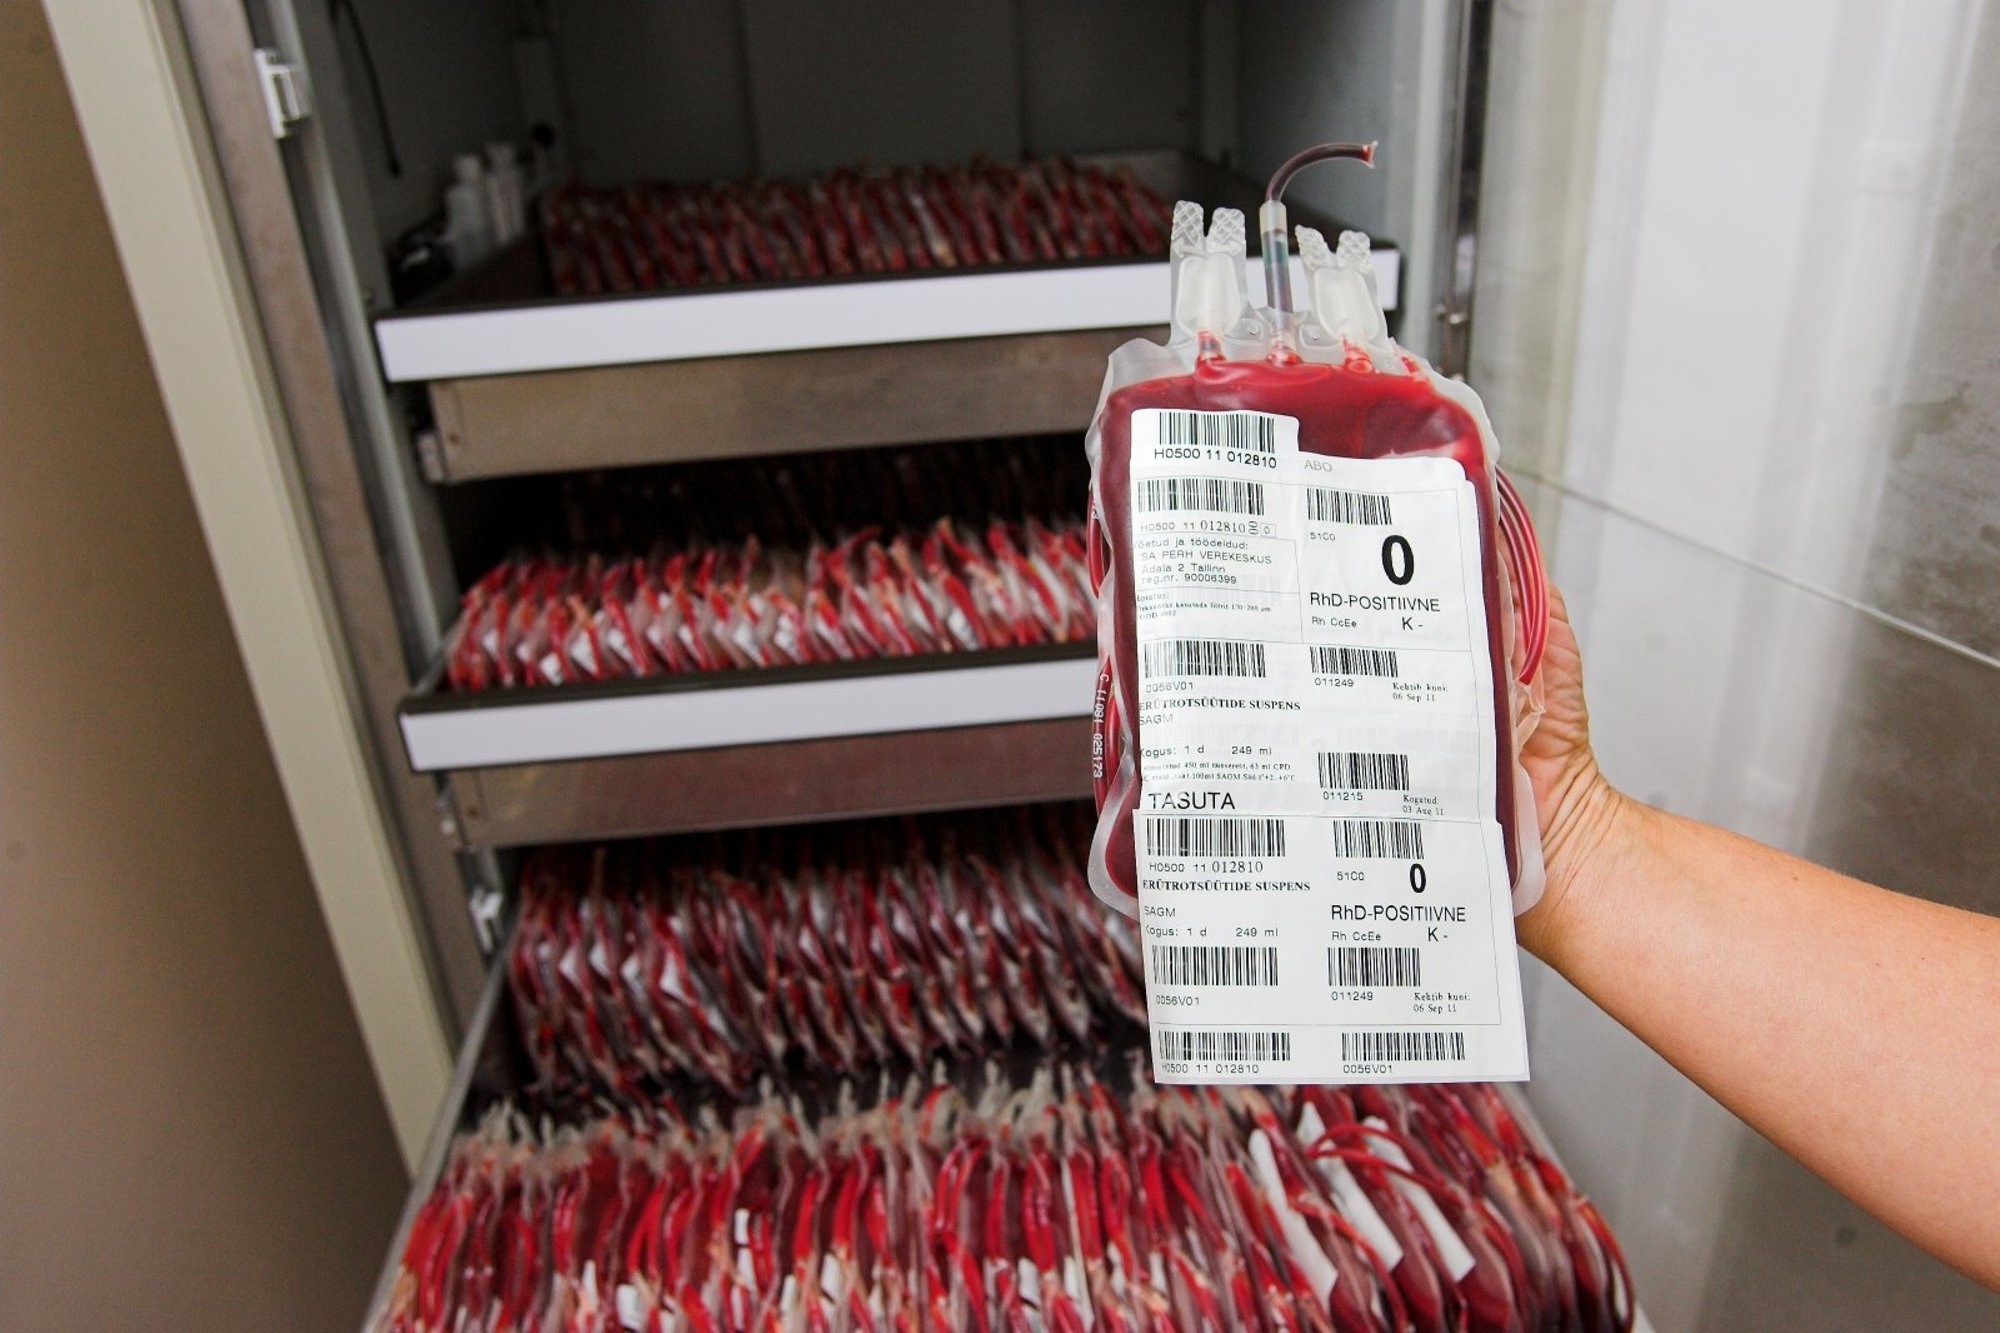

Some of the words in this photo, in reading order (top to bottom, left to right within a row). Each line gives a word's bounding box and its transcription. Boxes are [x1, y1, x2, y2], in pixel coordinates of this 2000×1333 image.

[1154, 448, 1200, 460] H0500
[1206, 450, 1220, 461] 11
[1227, 451, 1276, 468] 012810
[1304, 459, 1332, 472] ABO
[1141, 522, 1175, 532] H0500
[1183, 522, 1195, 530] 11
[1200, 520, 1246, 533] 012810
[1176, 538, 1185, 548] ja
[1191, 538, 1249, 550] töödeldud:
[1141, 552, 1157, 562] SA
[1162, 550, 1193, 560] PERH
[1200, 551, 1272, 564] VEREKESKUS
[1178, 563, 1185, 572] 2
[1192, 563, 1225, 573] Tallinn
[1185, 573, 1237, 584] 90006399
[1310, 592, 1441, 612] RhD-POSITIIVNE
[1312, 616, 1325, 626] Rh
[1331, 617, 1357, 628] CcEe
[1314, 677, 1354, 688] 011249
[1393, 682, 1422, 692] Kehtib
[1406, 693, 1422, 702] Sep
[1249, 698, 1301, 711] SUSPENS
[1139, 714, 1173, 726] SAGM
[1184, 746, 1190, 754] 1
[1197, 745, 1205, 754] d
[1232, 745, 1252, 755] 249
[1259, 746, 1272, 755] ml
[1148, 791, 1236, 810] TASUTA
[1323, 791, 1363, 801] 011215
[1415, 806, 1432, 816] Aug
[1149, 863, 1185, 873] H0500
[1194, 864, 1206, 873] 11
[1212, 861, 1263, 873] 012810
[1337, 872, 1365, 881] 51C0
[1143, 878, 1252, 891] ERÜTROTSÜÜTIDE
[1255, 881, 1311, 891] SUSPENS
[1144, 905, 1176, 917] SAGM
[1331, 905, 1466, 922] RhD-POSITIIVNE
[1187, 927, 1192, 936] 1
[1200, 926, 1207, 936] d
[1236, 927, 1257, 937] 249
[1264, 927, 1278, 937] ml
[1332, 931, 1347, 941] Rh
[1353, 931, 1381, 941] CcEe
[1155, 994, 1199, 1006] 0056V01
[1331, 991, 1373, 1001] 011249
[1414, 992, 1443, 1001] Kehtib
[1413, 1004, 1424, 1013] 06
[1428, 1004, 1443, 1014] Sep
[1448, 1004, 1457, 1013] 11
[1162, 1064, 1188, 1073] H0500
[1196, 1064, 1209, 1073] 11
[1216, 1064, 1259, 1074] 012810
[1343, 1064, 1393, 1074] 0056V01
